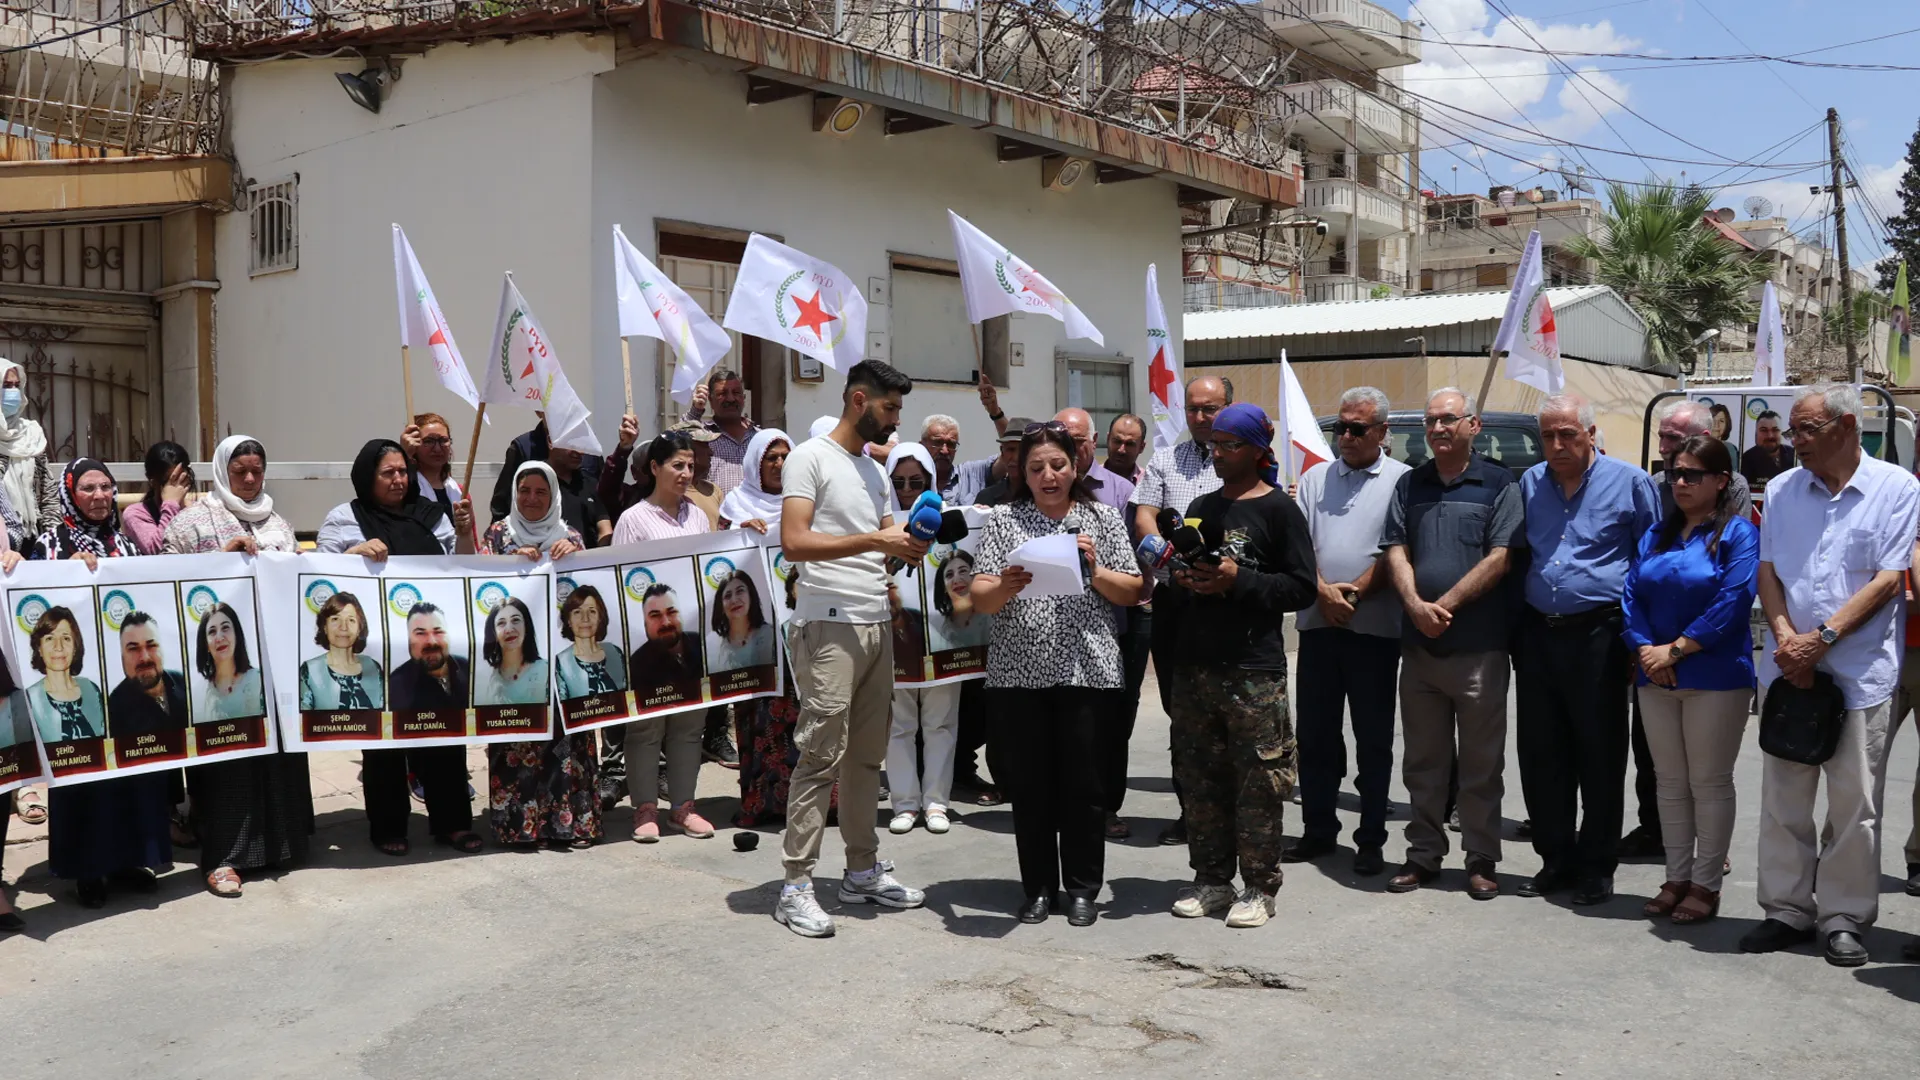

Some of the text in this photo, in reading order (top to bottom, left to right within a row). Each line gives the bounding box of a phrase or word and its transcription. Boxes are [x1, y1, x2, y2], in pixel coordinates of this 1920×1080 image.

[811, 273, 834, 288] PYD
[528, 327, 548, 358] PYD
[794, 333, 818, 350] 2003
[500, 707, 518, 718] ŞEHİD
[330, 713, 351, 724] ŞEHİD
[486, 719, 507, 728] YUSRA
[403, 722, 423, 731] FIRAT
[206, 736, 226, 746] YUSRA
[55, 745, 75, 758] ŞEHİD
[125, 747, 144, 758] FIRAT
